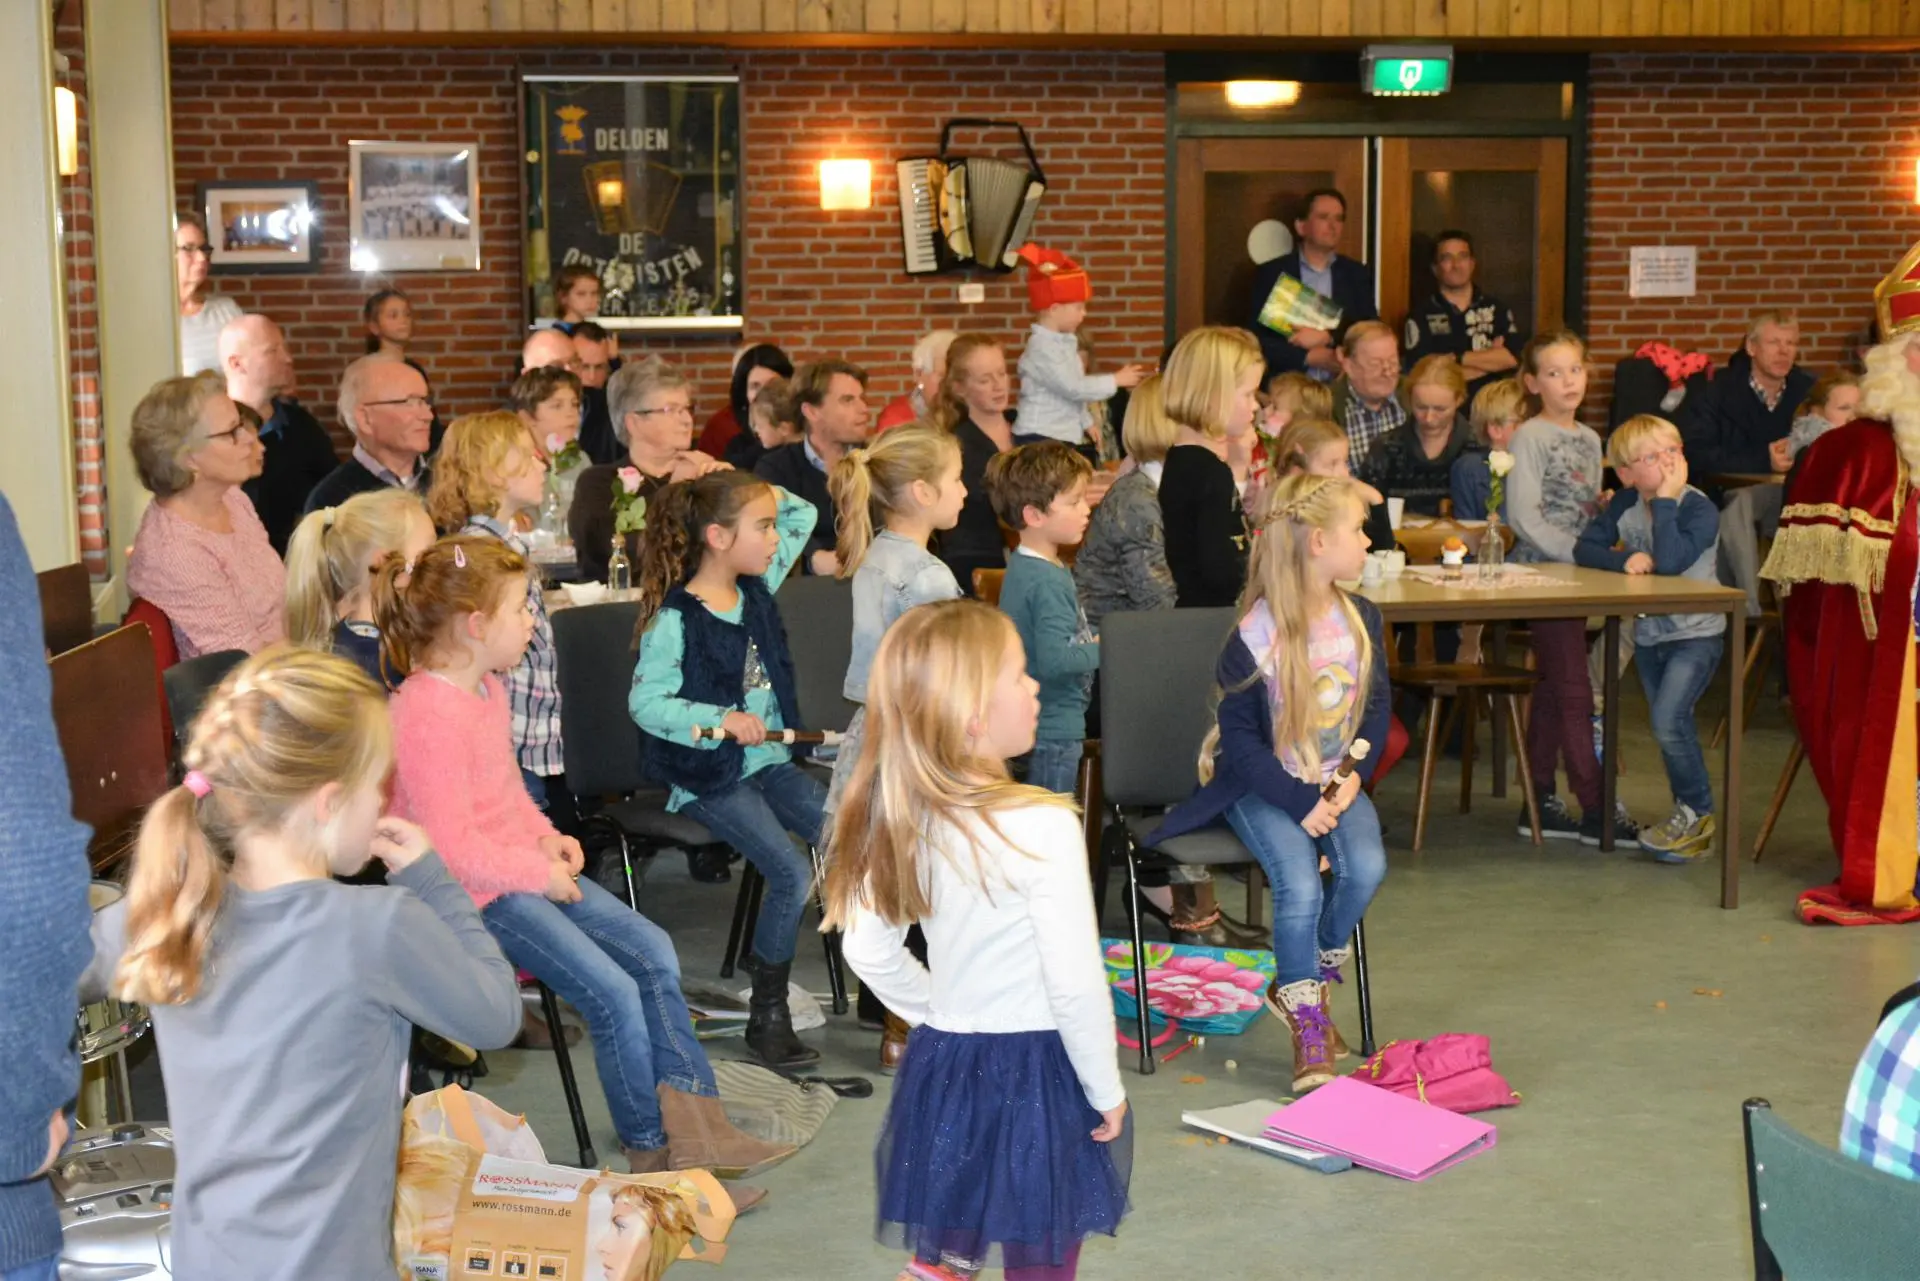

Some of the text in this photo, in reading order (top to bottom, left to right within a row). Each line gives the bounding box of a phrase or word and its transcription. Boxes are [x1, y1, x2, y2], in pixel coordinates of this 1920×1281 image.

[594, 128, 669, 151] DELDEN
[618, 232, 645, 255] DE
[479, 1174, 578, 1189] ROSSMANN
[472, 1200, 572, 1217] www.rossmann.de
[415, 1265, 438, 1274] ISANA
